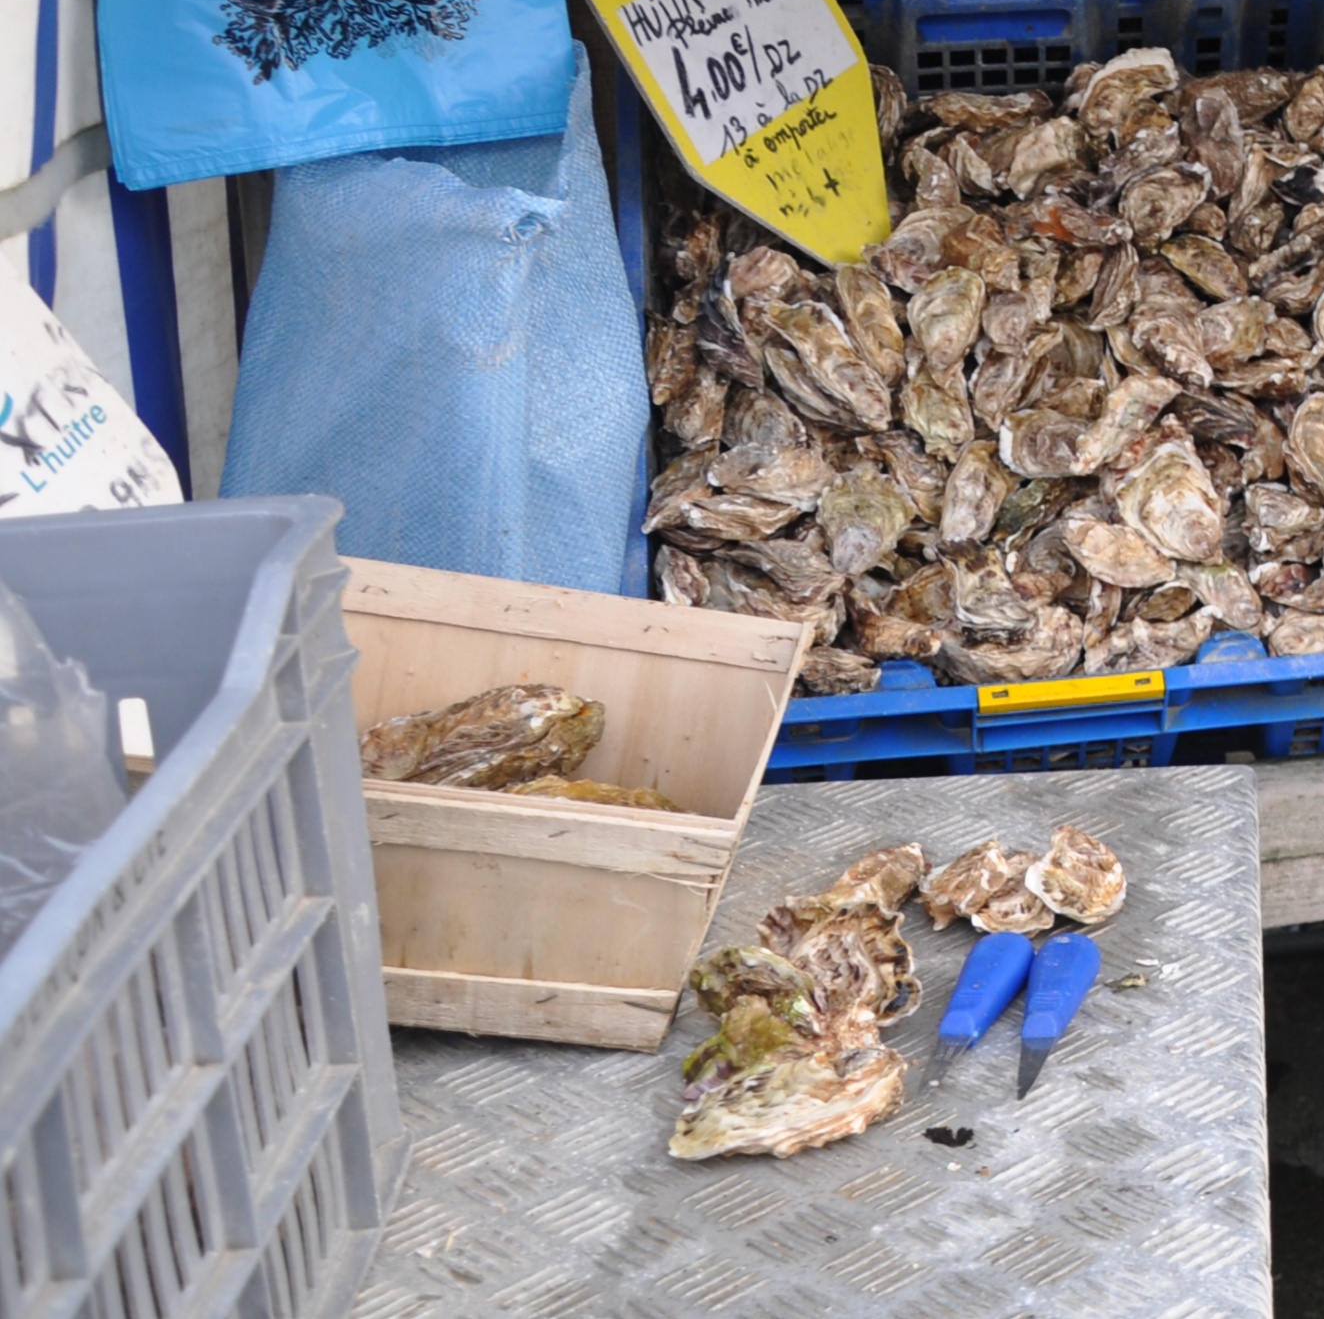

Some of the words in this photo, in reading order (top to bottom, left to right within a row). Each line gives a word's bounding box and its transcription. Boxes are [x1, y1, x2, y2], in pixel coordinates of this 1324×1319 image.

[720, 116, 747, 158] 13
[756, 101, 773, 127] à
[775, 79, 804, 111] la
[744, 148, 759, 169] à
